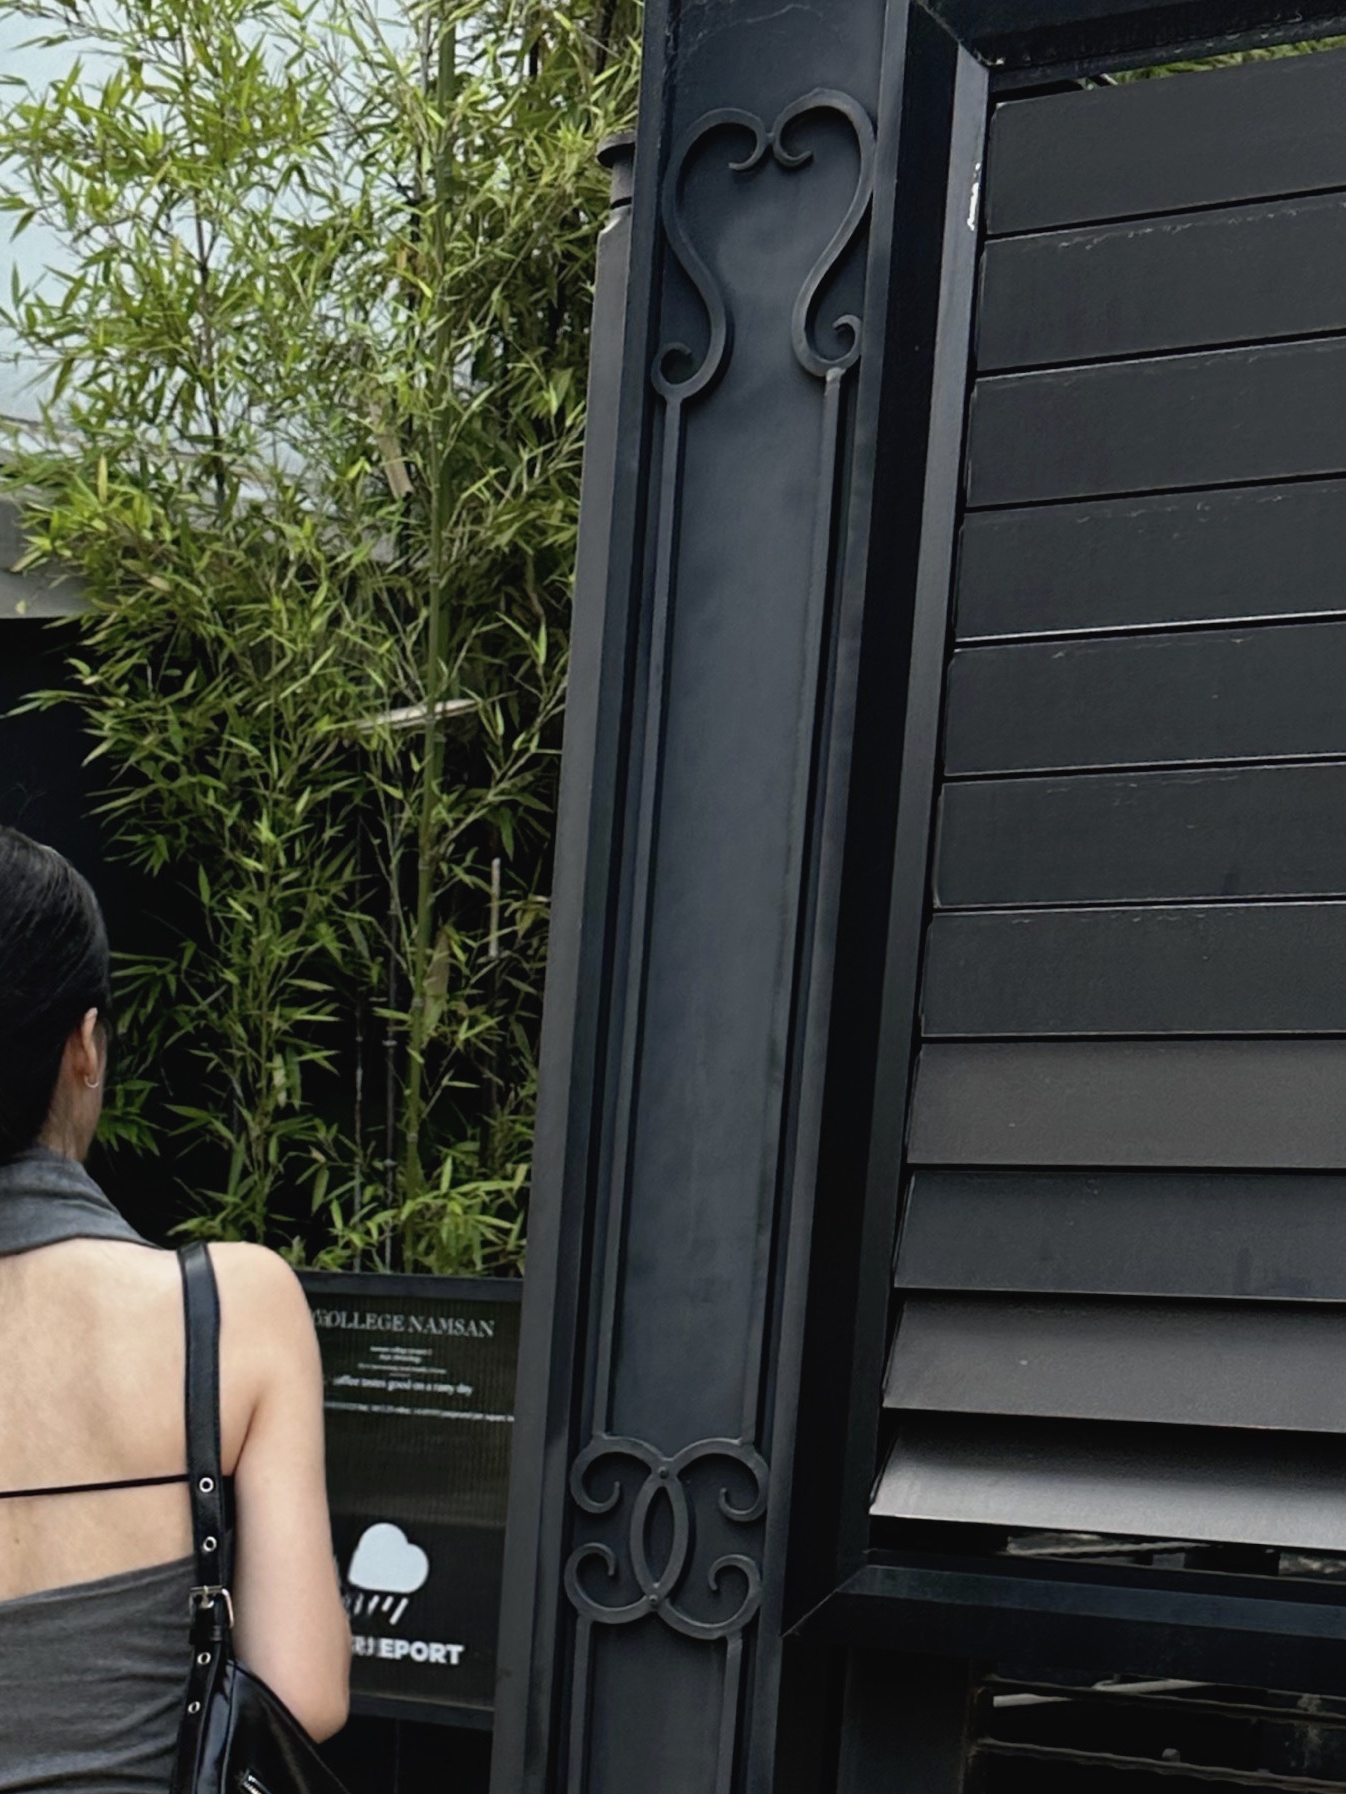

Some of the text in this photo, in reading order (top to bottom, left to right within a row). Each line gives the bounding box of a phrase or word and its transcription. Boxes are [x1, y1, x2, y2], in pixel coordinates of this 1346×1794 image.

[407, 1314, 495, 1338] NAMSAN
[387, 1379, 412, 1392] good
[456, 1383, 474, 1396] day
